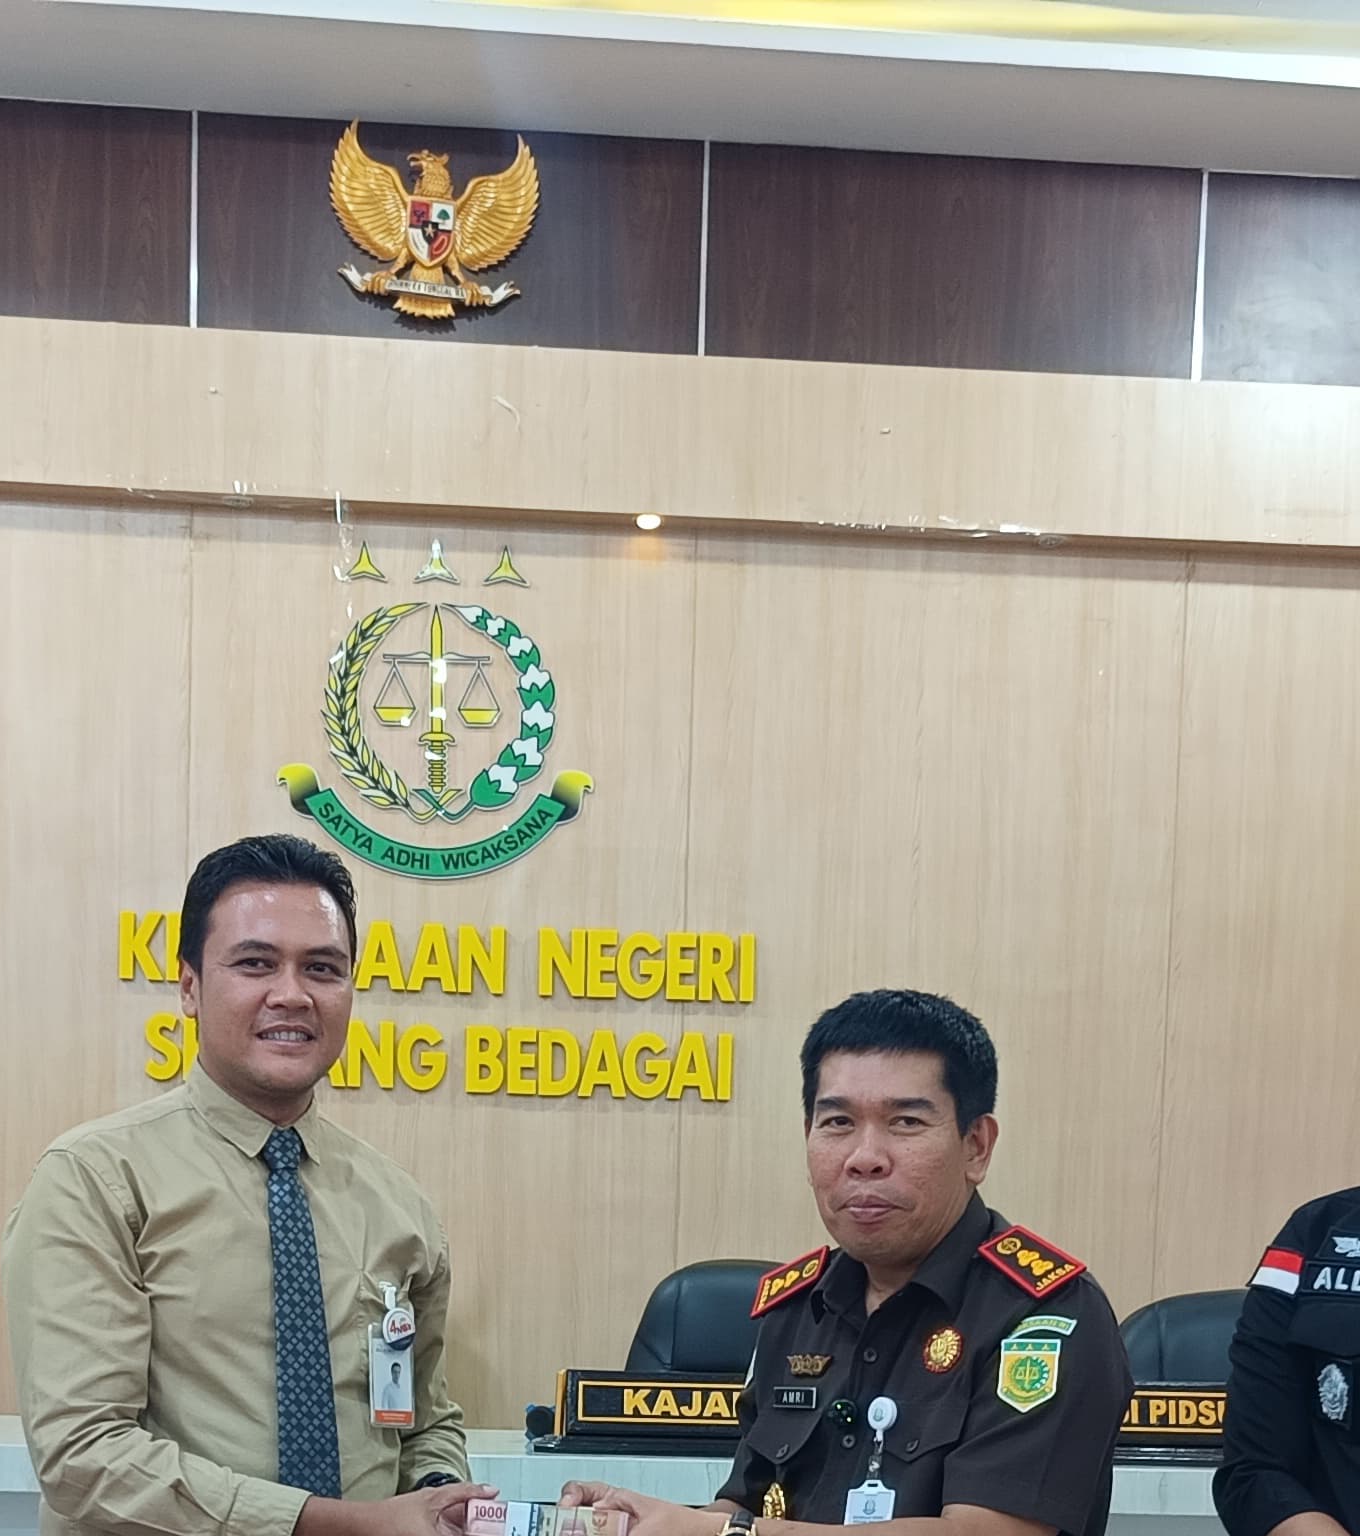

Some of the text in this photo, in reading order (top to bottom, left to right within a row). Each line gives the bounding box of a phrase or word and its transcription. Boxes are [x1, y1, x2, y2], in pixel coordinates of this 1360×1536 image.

[318, 802, 554, 870] SATYA ADHI WICAKSANA
[539, 927, 755, 1002] NEGERI
[464, 1025, 733, 1102] BEDAGAI
[1036, 1264, 1075, 1291] JAKSA
[782, 1391, 805, 1404] AMRI
[475, 1505, 506, 1520] 1000
